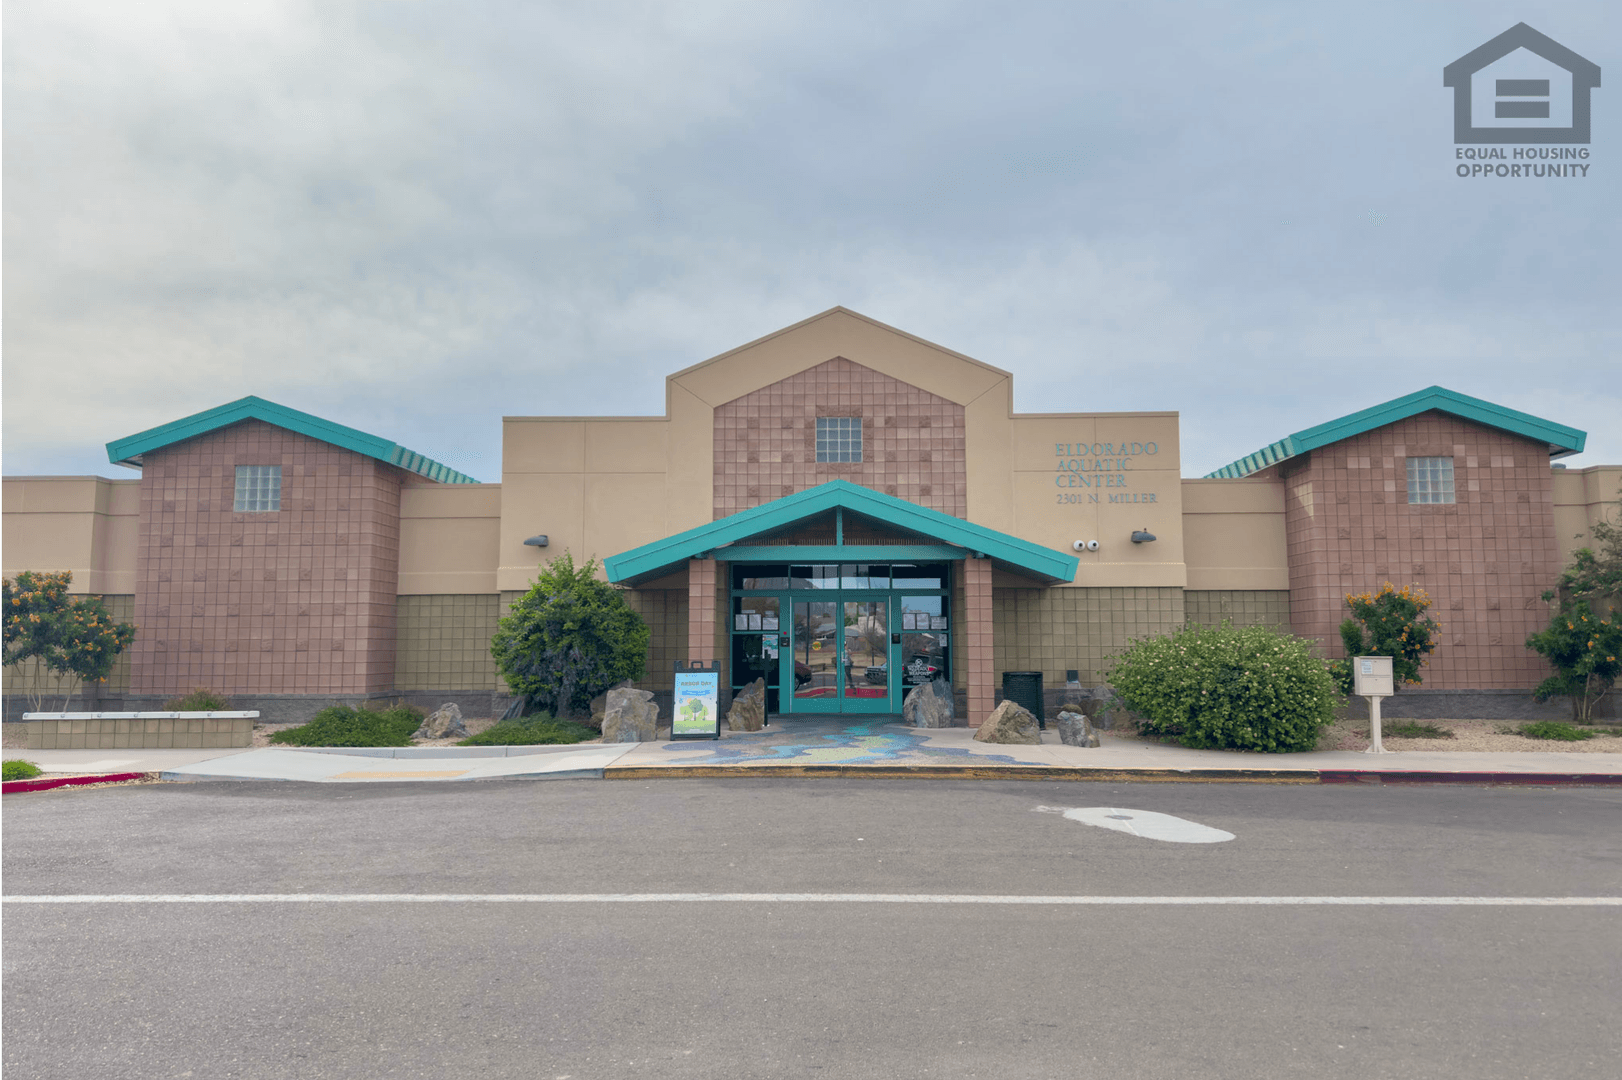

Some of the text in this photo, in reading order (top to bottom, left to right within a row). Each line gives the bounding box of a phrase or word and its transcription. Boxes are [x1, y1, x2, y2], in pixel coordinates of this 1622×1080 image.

[1055, 442, 1158, 456] ELDORADO
[1056, 457, 1133, 474] AQUATIC
[1055, 474, 1128, 488] CENTER
[1056, 493, 1083, 504] 2301
[1109, 493, 1158, 503] MILLER
